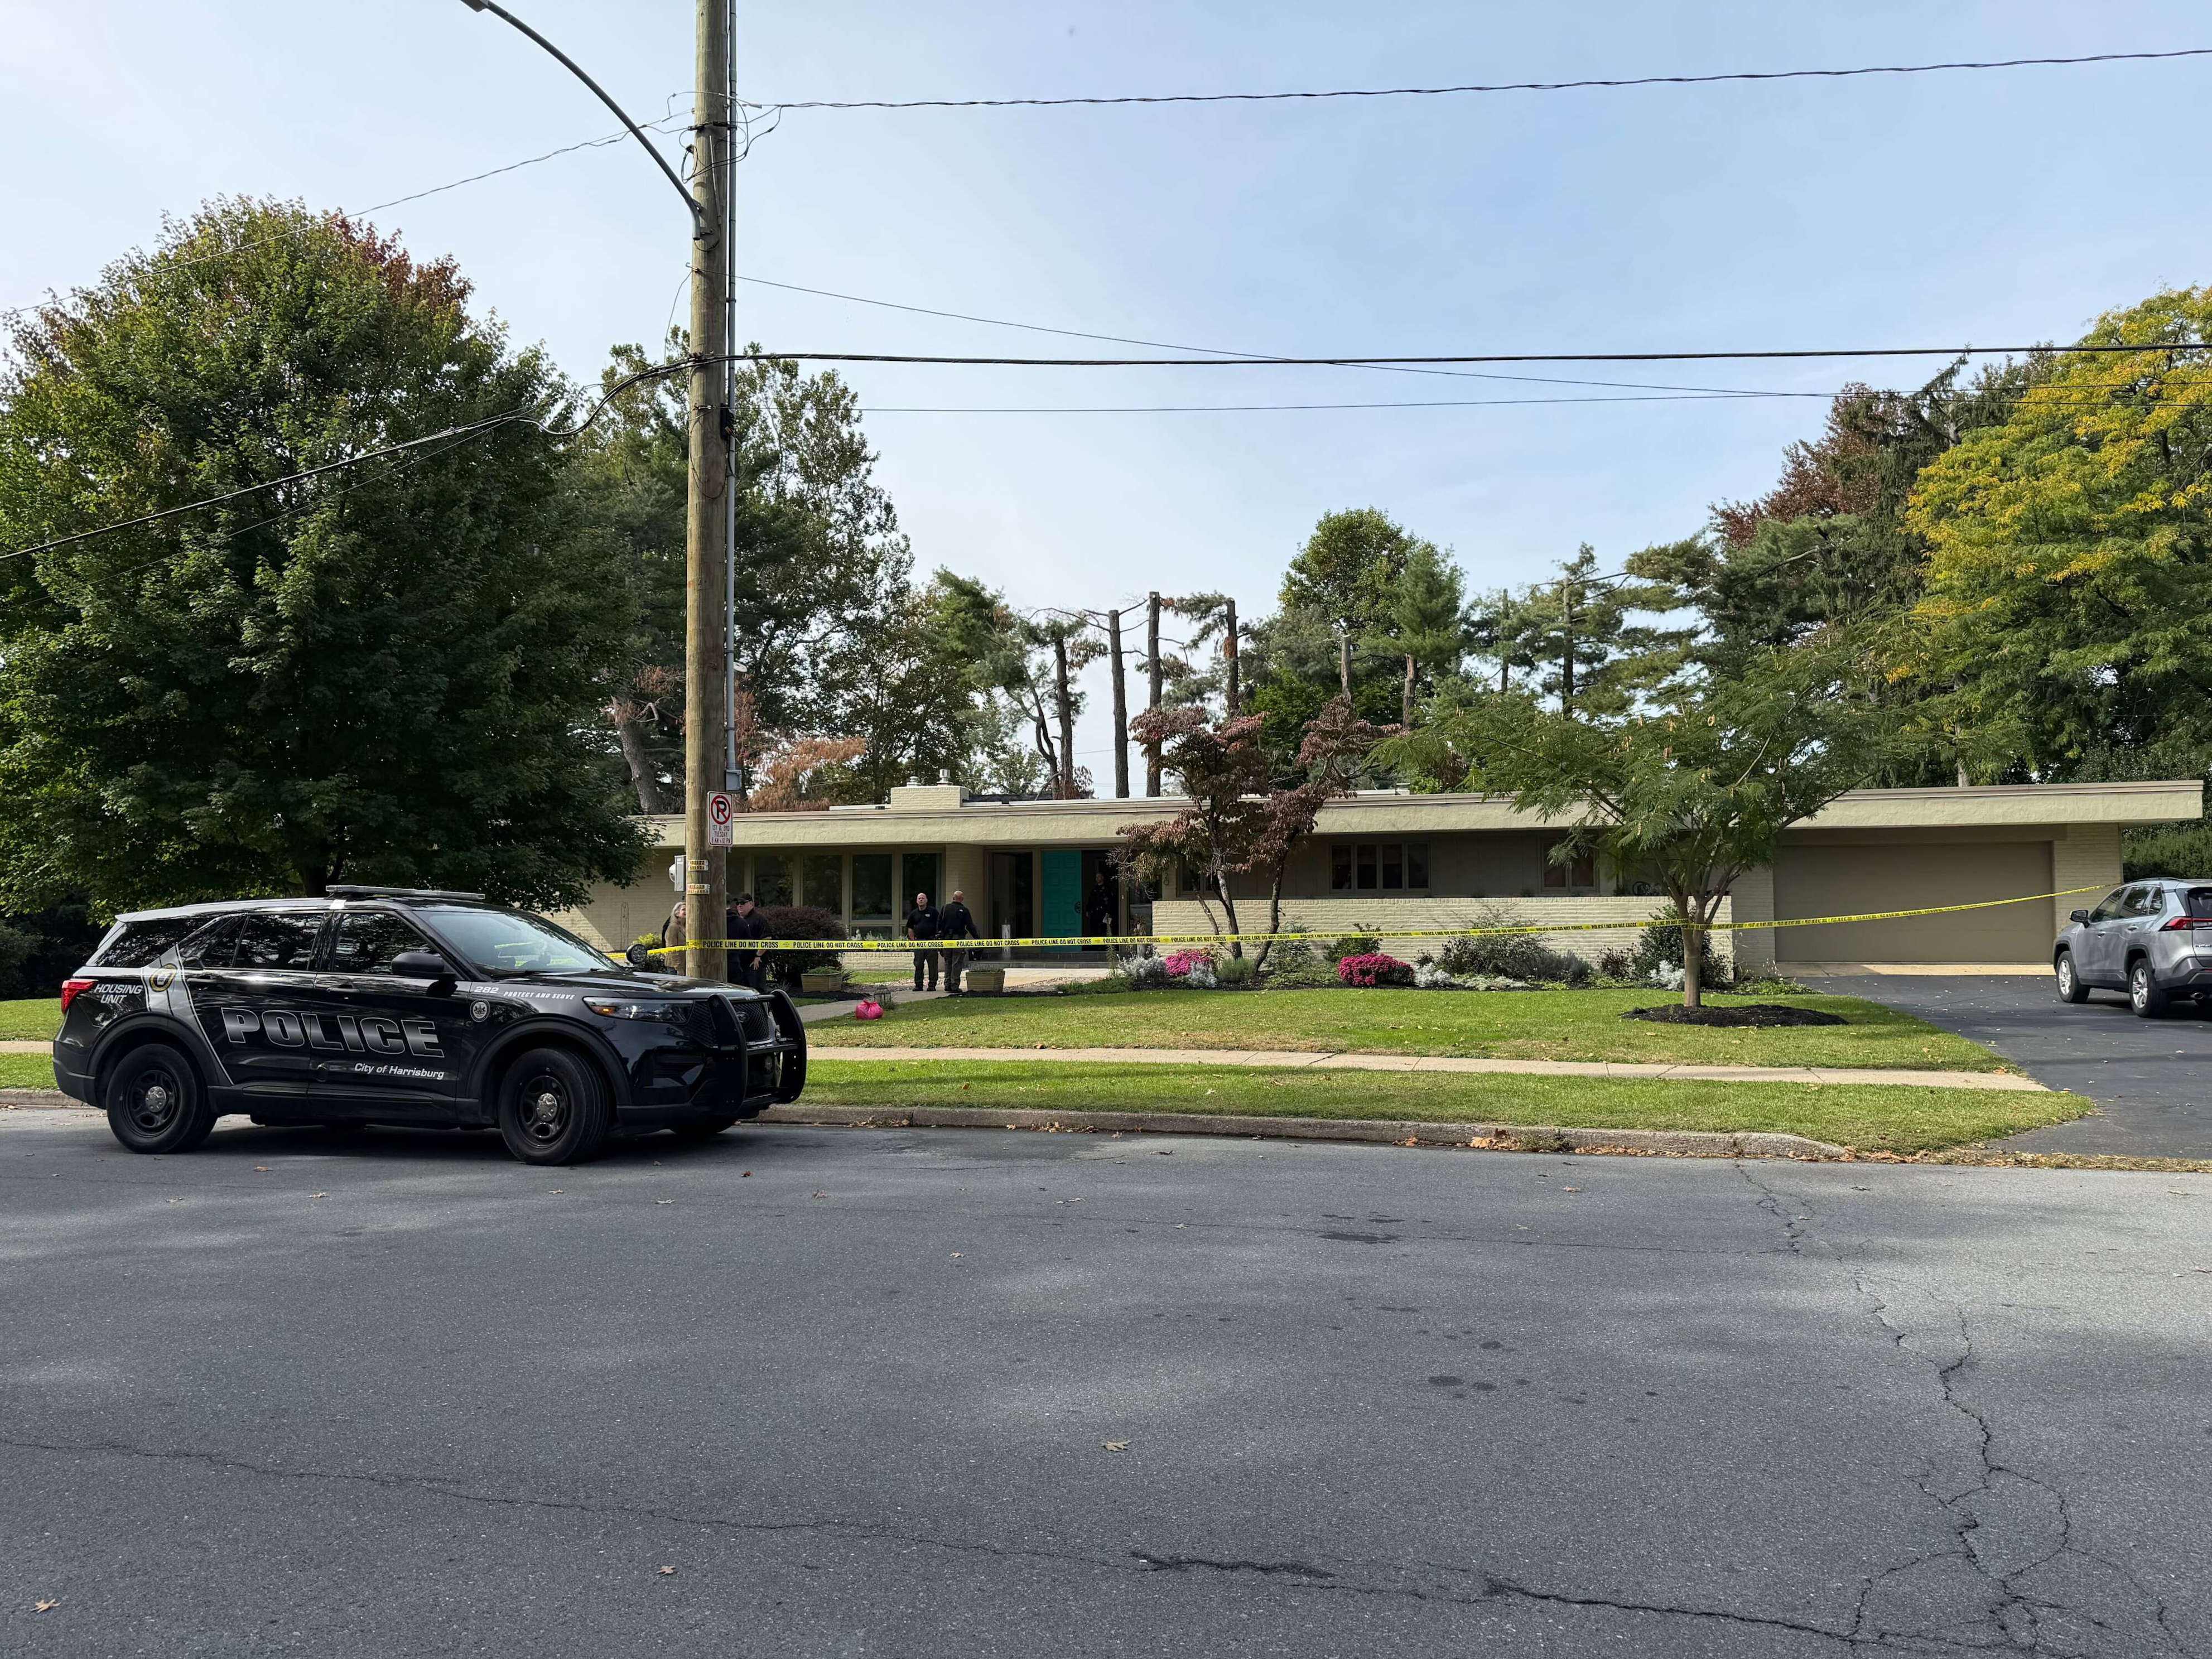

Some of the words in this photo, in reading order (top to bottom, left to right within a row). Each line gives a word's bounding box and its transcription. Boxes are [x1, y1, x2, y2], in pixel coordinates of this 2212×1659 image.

[94, 984, 143, 994] HOUSING
[100, 995, 127, 1004] UNIT
[220, 1007, 445, 1058] POLICE
[354, 1063, 374, 1074] City
[376, 1065, 388, 1073] of
[389, 1065, 445, 1080] Harrisburg
